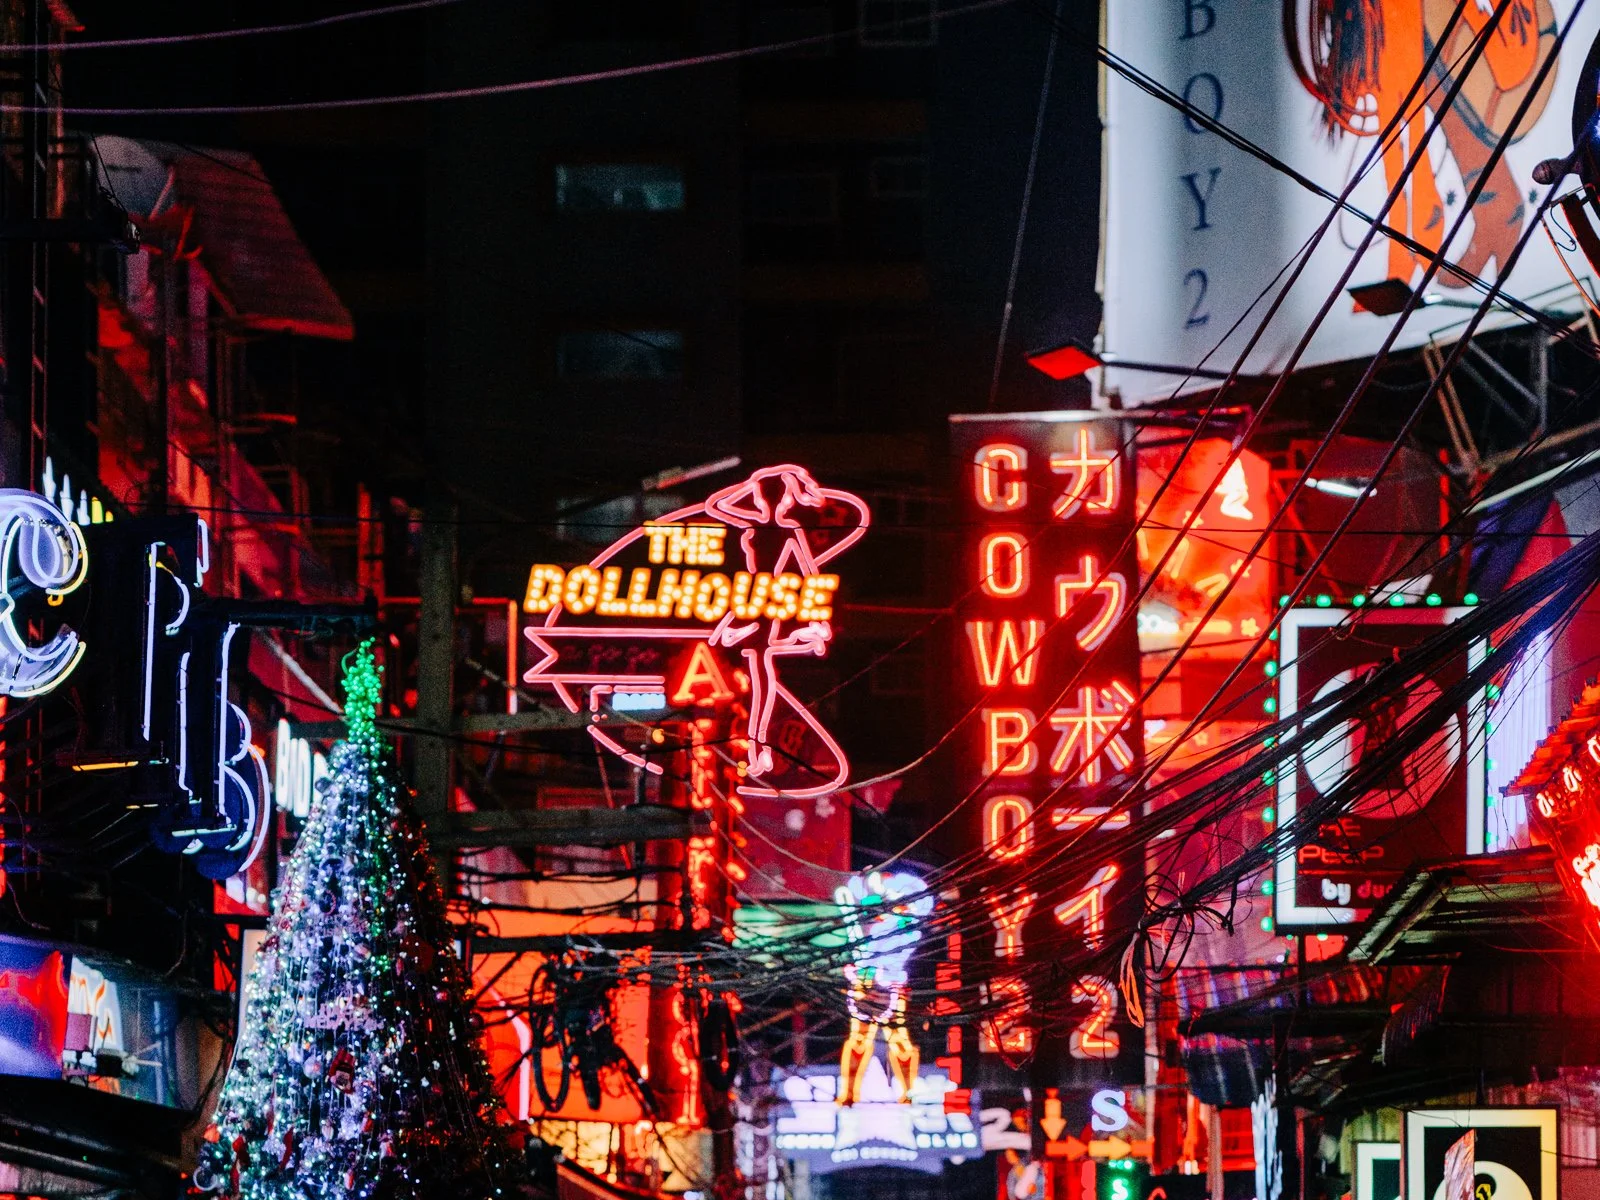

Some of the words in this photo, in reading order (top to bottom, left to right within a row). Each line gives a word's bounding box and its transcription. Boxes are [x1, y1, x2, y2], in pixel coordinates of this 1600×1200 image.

[643, 520, 727, 566] THE
[522, 564, 840, 622] DOLLHOUSE
[1321, 878, 1351, 906] by
